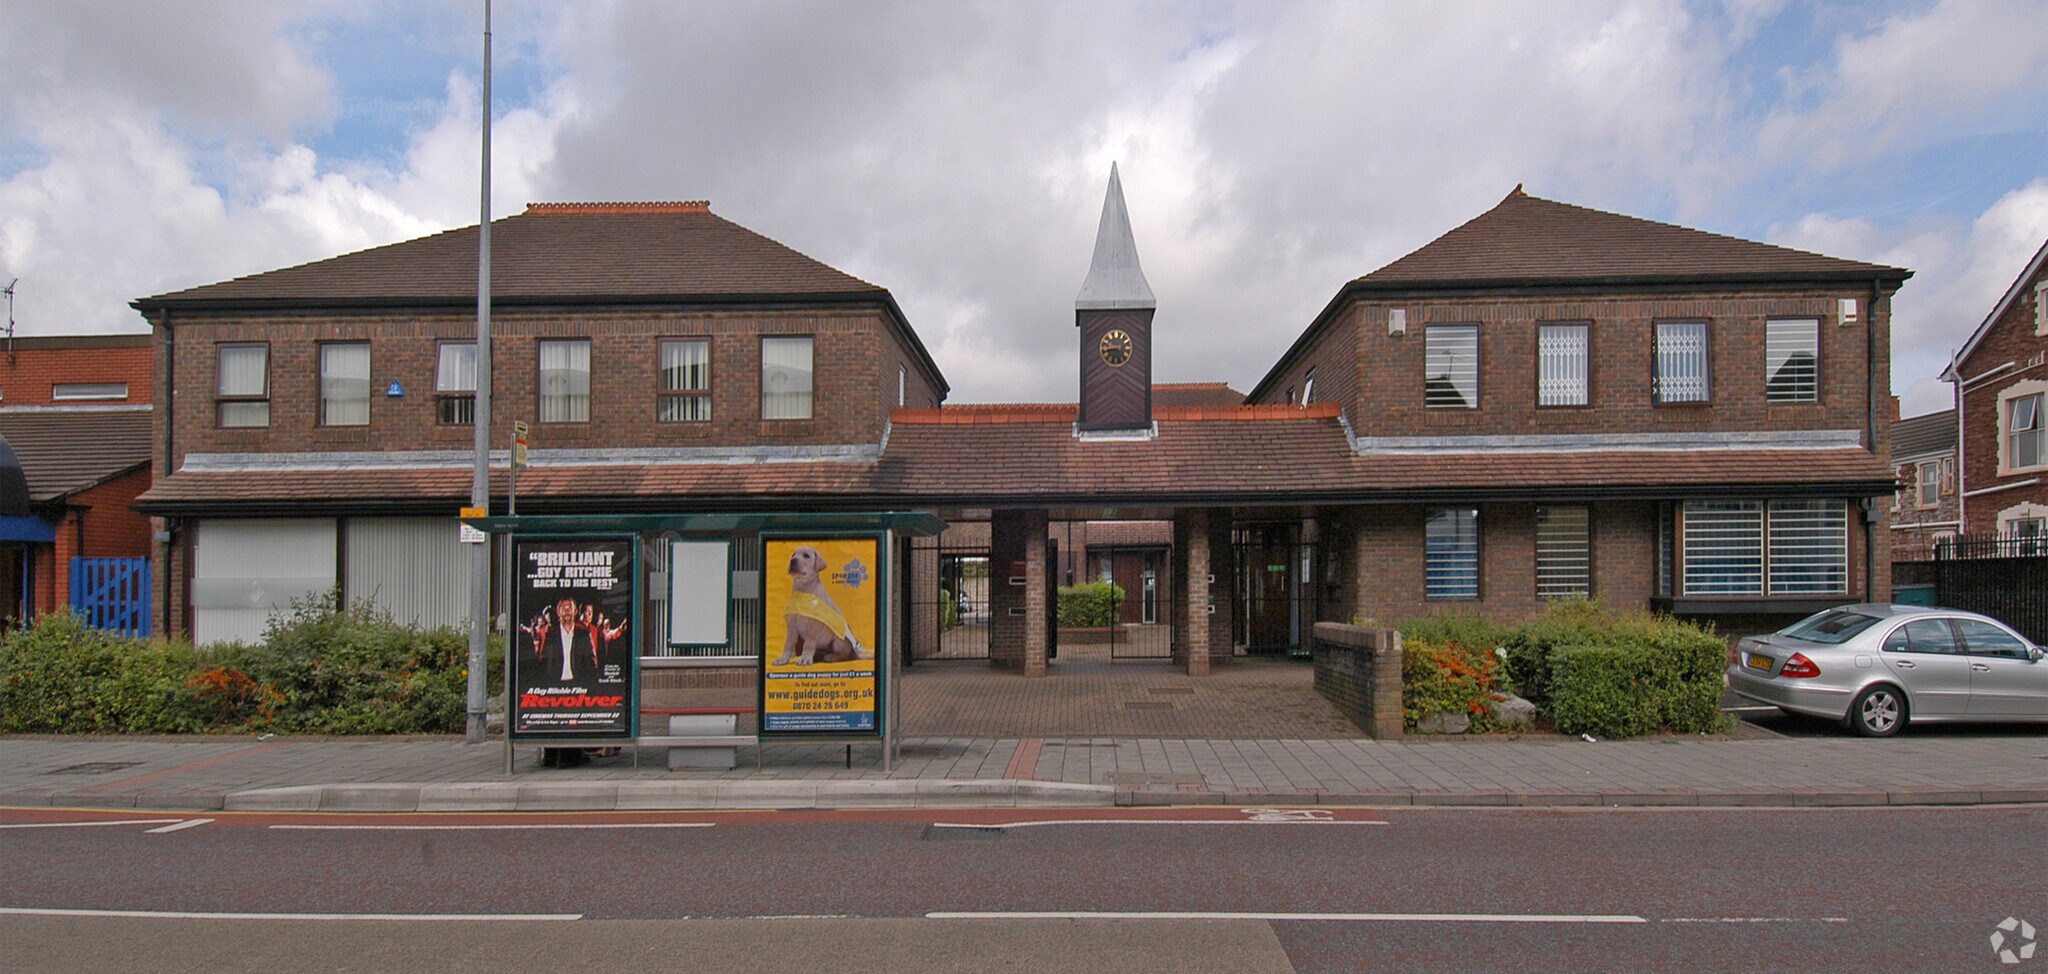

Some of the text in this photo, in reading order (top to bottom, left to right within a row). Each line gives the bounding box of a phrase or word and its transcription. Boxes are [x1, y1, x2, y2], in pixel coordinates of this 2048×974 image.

[564, 566, 612, 578] RITCHIE
[533, 579, 557, 588] BACK
[559, 579, 571, 588] TO
[573, 579, 589, 587] HIS
[534, 688, 547, 696] Guy
[547, 687, 571, 695] Ritchie
[571, 686, 588, 694] Film
[768, 687, 873, 700] www.guidedogs.org.uk
[520, 694, 623, 708] Revolver
[793, 702, 811, 710] 0870
[835, 701, 849, 709] 649
